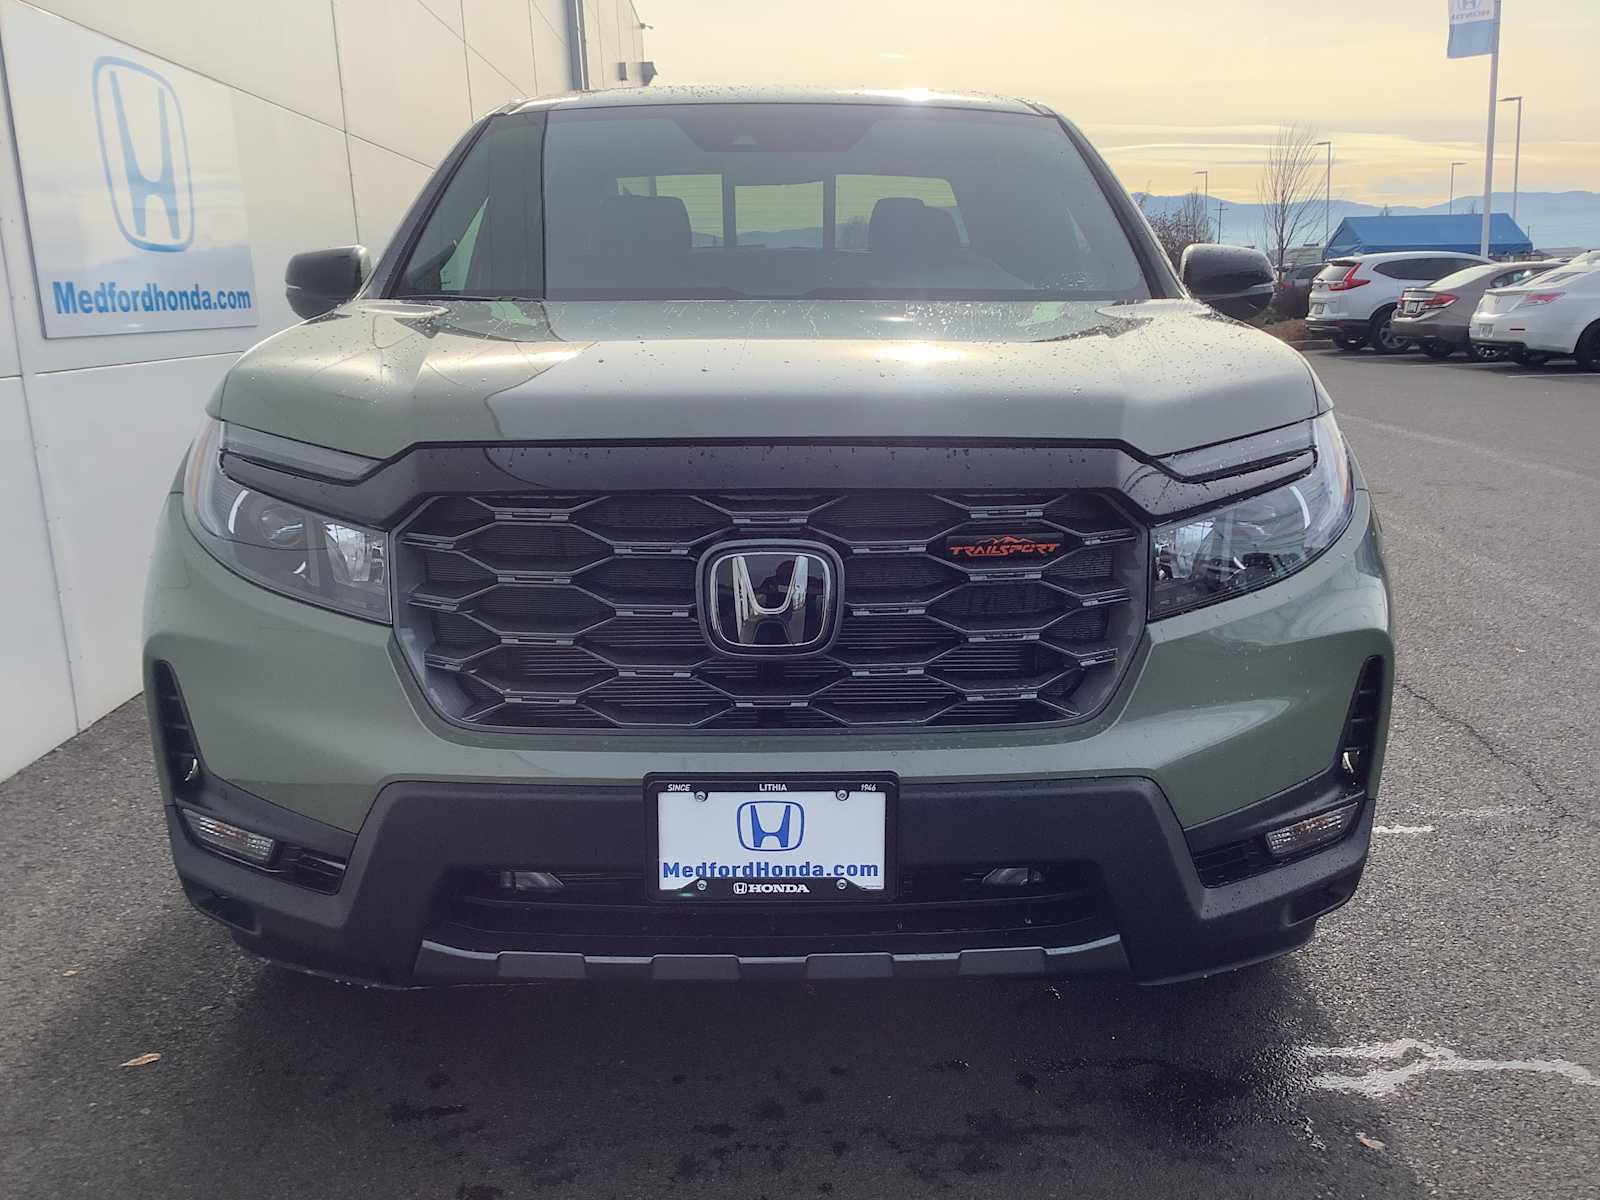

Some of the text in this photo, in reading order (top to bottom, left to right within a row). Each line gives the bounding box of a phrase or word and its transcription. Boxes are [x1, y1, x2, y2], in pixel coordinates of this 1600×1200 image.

[52, 281, 252, 314] Medfordhonda.com
[949, 543, 1060, 557] TRAILSPORT
[667, 783, 691, 792] SINCE
[759, 783, 787, 792] LITHIA
[663, 861, 879, 878] MedfordHonda.com
[748, 883, 810, 893] HONDA
